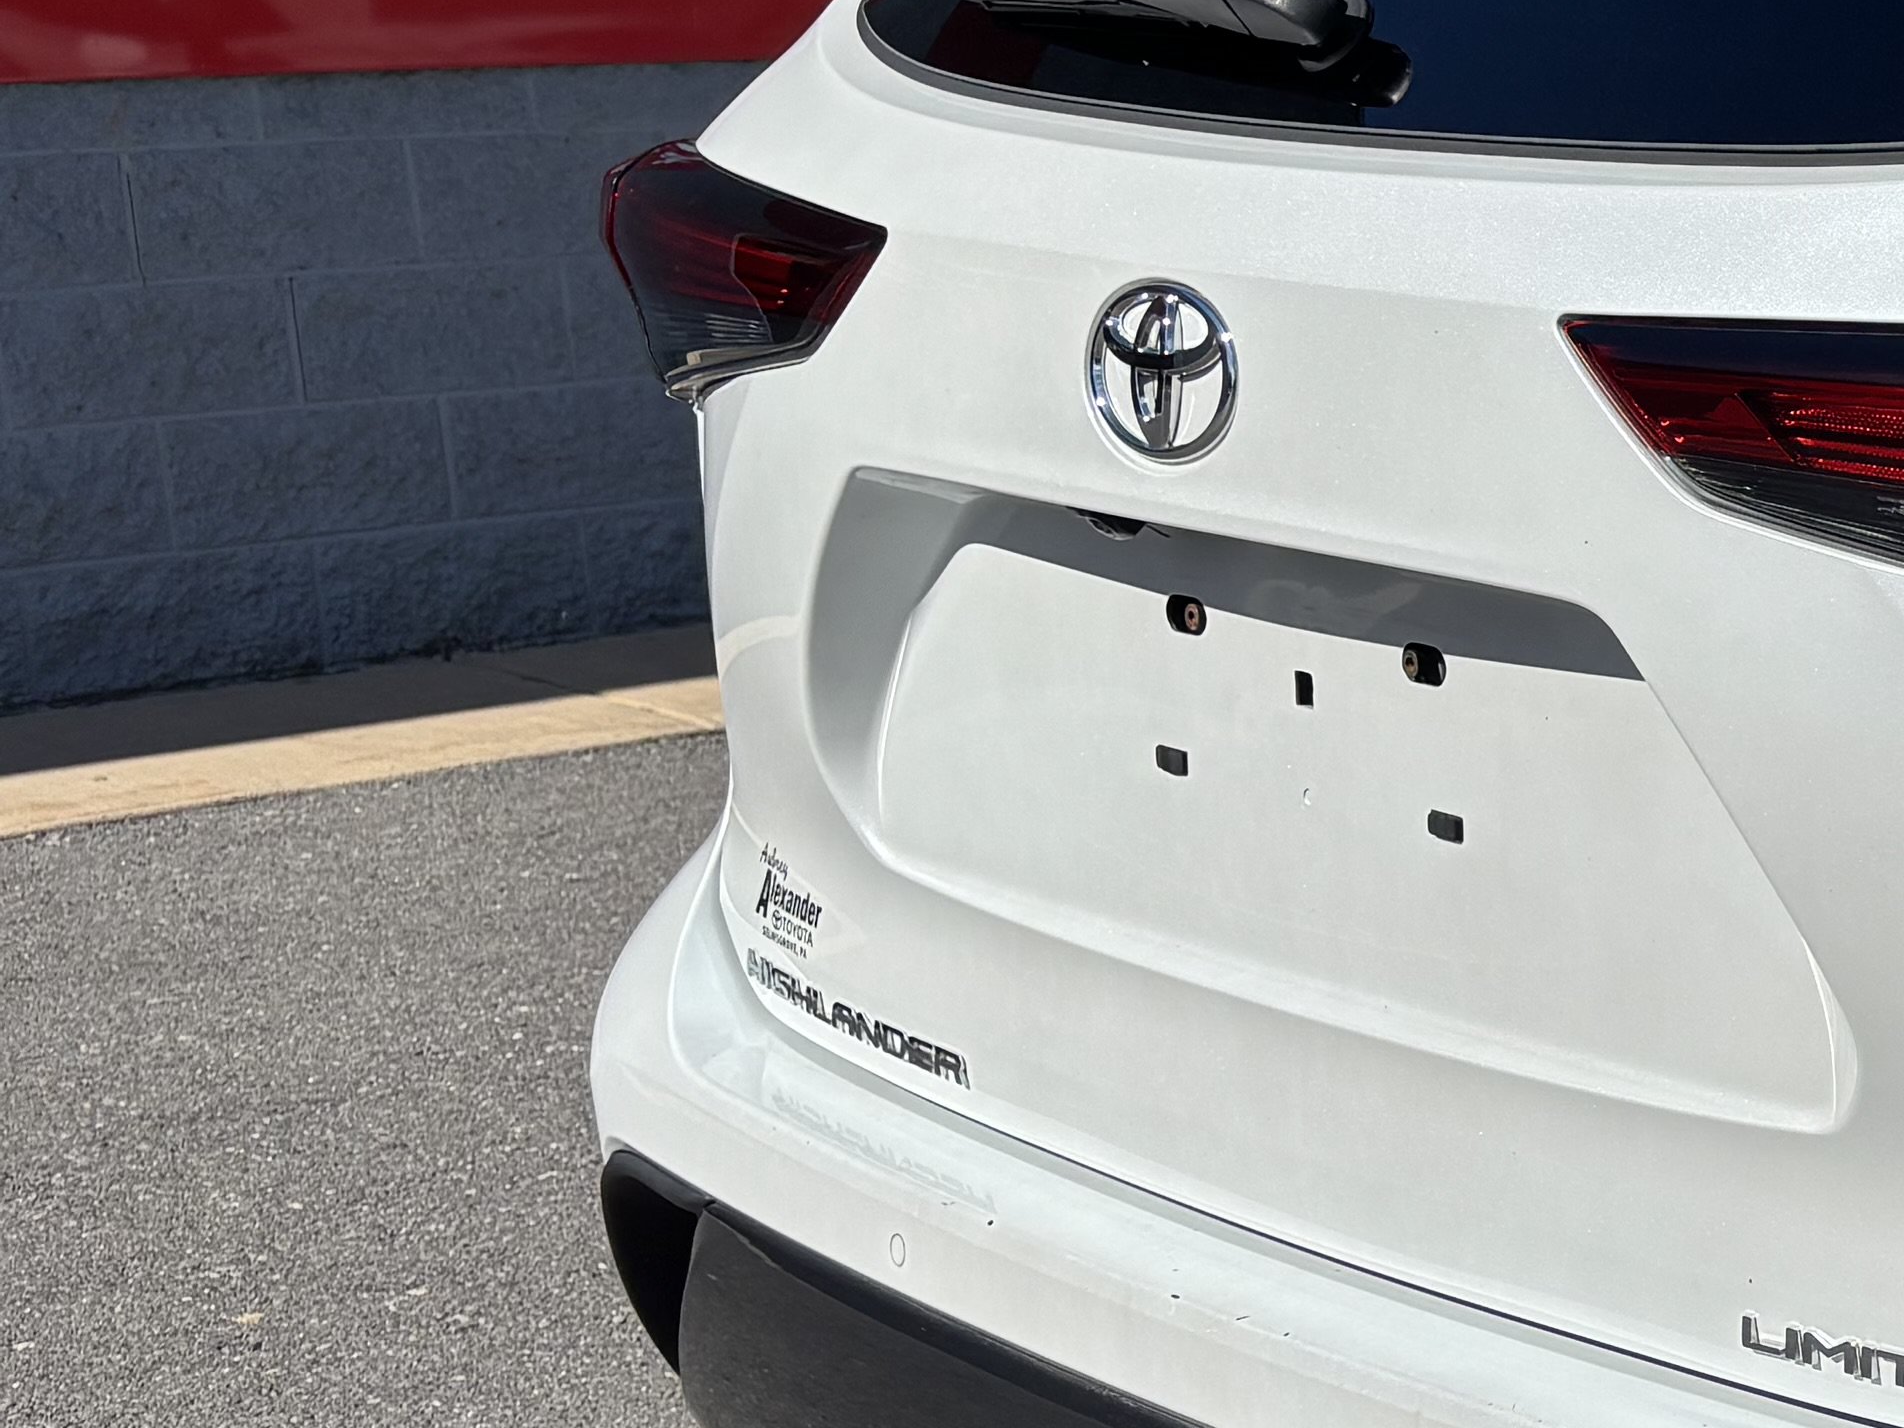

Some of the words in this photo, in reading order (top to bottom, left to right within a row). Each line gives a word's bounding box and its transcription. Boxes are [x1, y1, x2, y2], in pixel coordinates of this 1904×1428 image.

[760, 842, 788, 881] Aubrey
[756, 868, 822, 928] Alexander
[783, 916, 813, 948] TOYOTA
[747, 947, 971, 1090] HIGHLANDER
